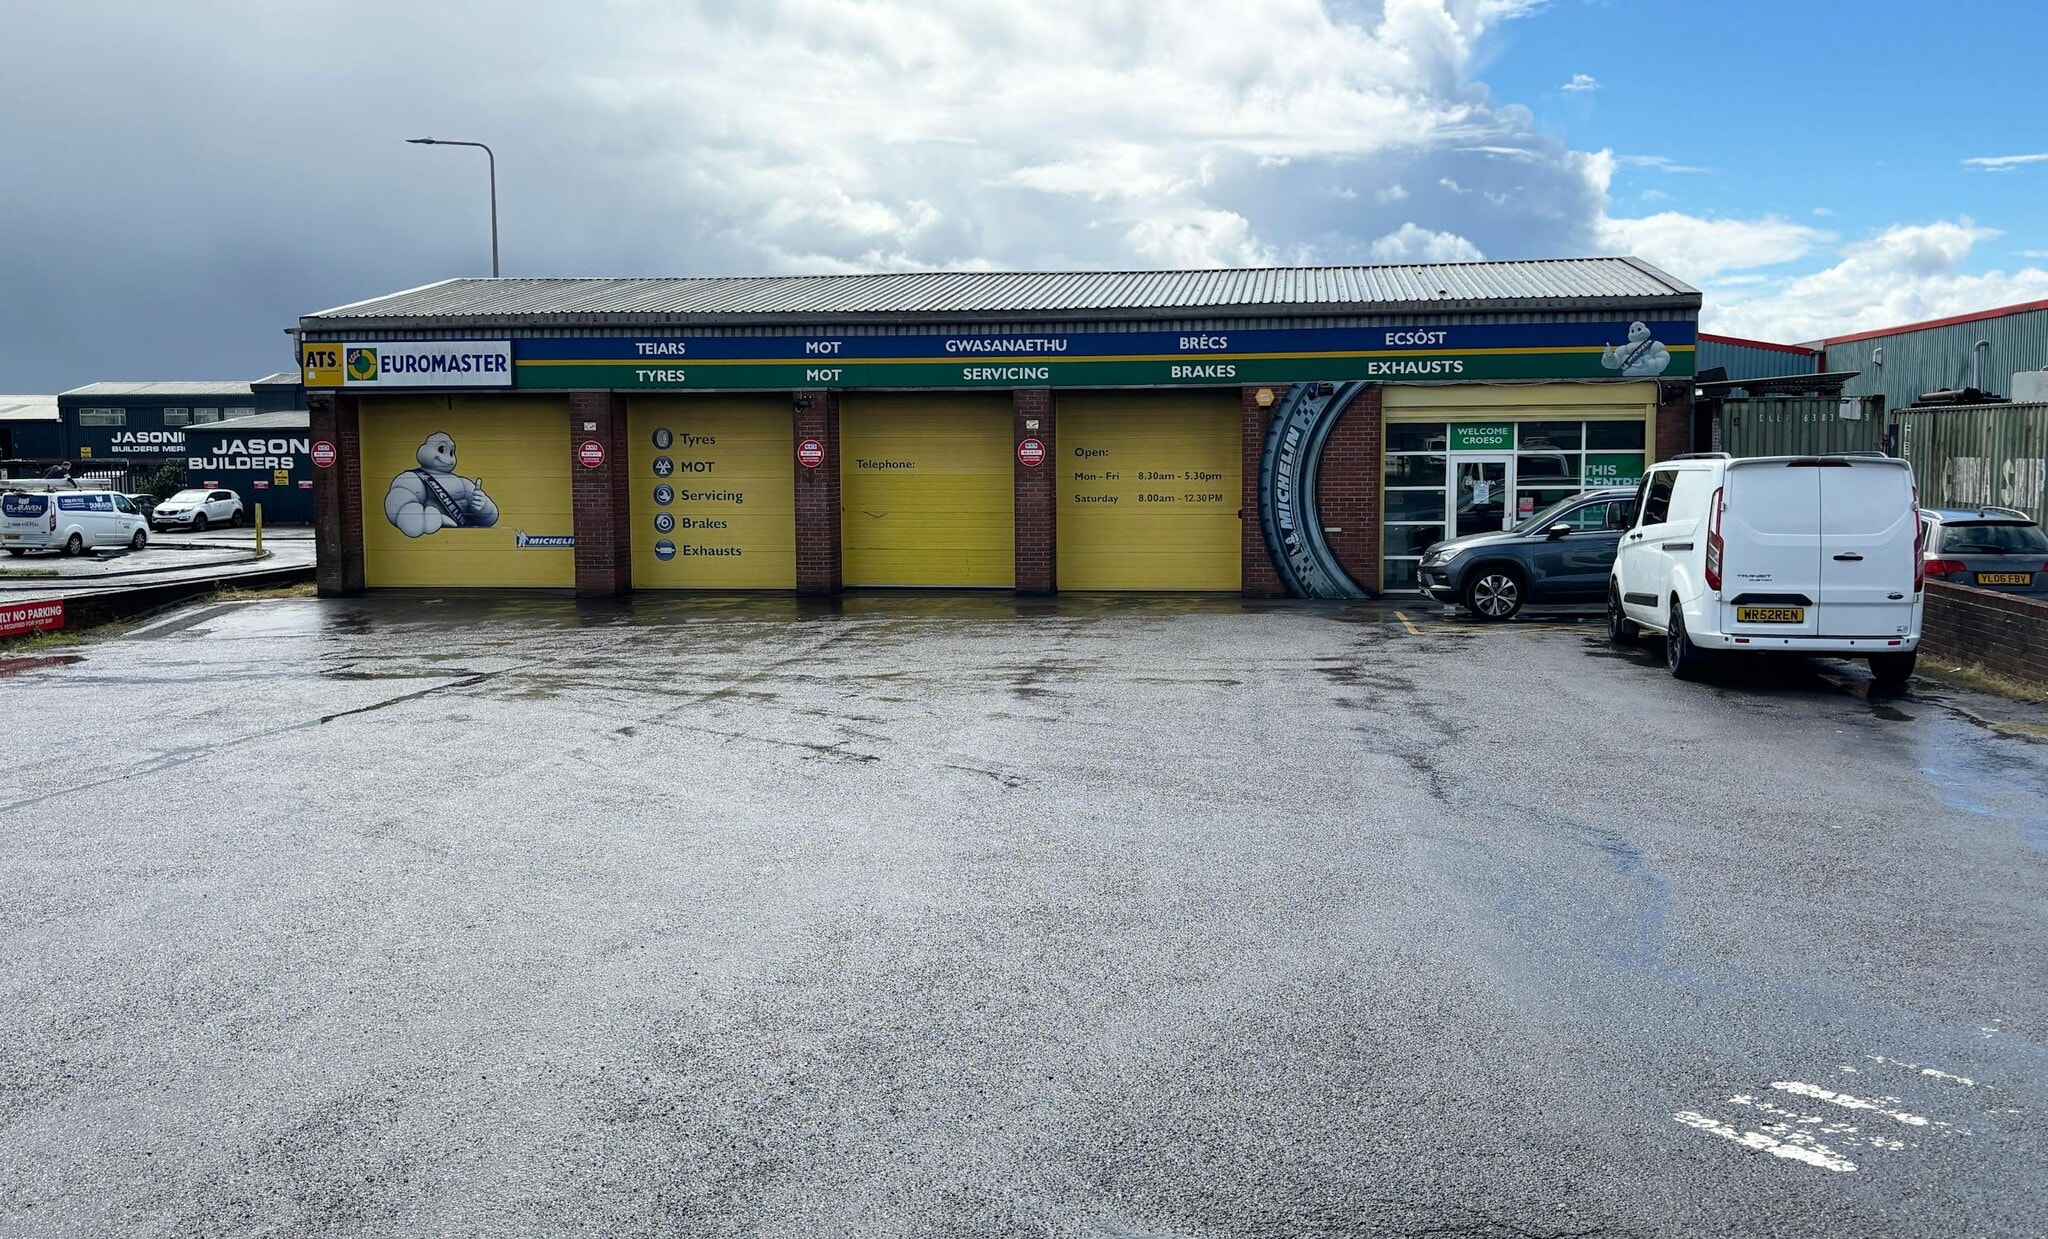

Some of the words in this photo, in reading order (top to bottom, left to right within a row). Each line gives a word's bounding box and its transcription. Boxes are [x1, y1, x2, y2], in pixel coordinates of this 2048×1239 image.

[1179, 334, 1228, 350] BRÊCS
[1385, 328, 1447, 345] ECSÔST
[636, 342, 685, 355] TEIARS
[806, 341, 842, 354] MOT
[945, 338, 1067, 352] GWASANAETHU
[381, 353, 508, 373] EUROMASTER
[1368, 360, 1463, 375] EXHAUSTS
[636, 370, 685, 382] TYRES
[806, 369, 842, 381] MOT
[963, 367, 1049, 380] SERVICING
[1171, 365, 1236, 378] BRAKES
[1457, 427, 1508, 435] WELCOME
[212, 438, 310, 455] JASON
[680, 433, 716, 447] Tyres
[1462, 436, 1502, 444] CROESO
[1074, 447, 1109, 459] Open:
[188, 457, 294, 470] BUILDERS
[681, 461, 715, 472] MOT
[856, 459, 915, 471] Telephone:
[1585, 464, 1617, 475] THIS
[1074, 472, 1097, 481] Mon
[1106, 472, 1120, 480] Fri
[1138, 471, 1175, 480] 8.30am
[1184, 471, 1222, 482] 5.30pm
[1277, 426, 1300, 530] MICHELIN
[429, 480, 466, 526] MICHELIN
[681, 490, 743, 504] Servicing
[1074, 494, 1119, 504] Saturday
[1138, 493, 1175, 502] 8.00am
[682, 517, 727, 529] Brakes
[683, 545, 742, 556] Exhausts
[1982, 573, 2006, 584] YL06
[2008, 573, 2026, 584] FBV
[13, 610, 26, 621] NO
[28, 605, 62, 620] PARKING
[1744, 609, 1798, 620] WR52REN
